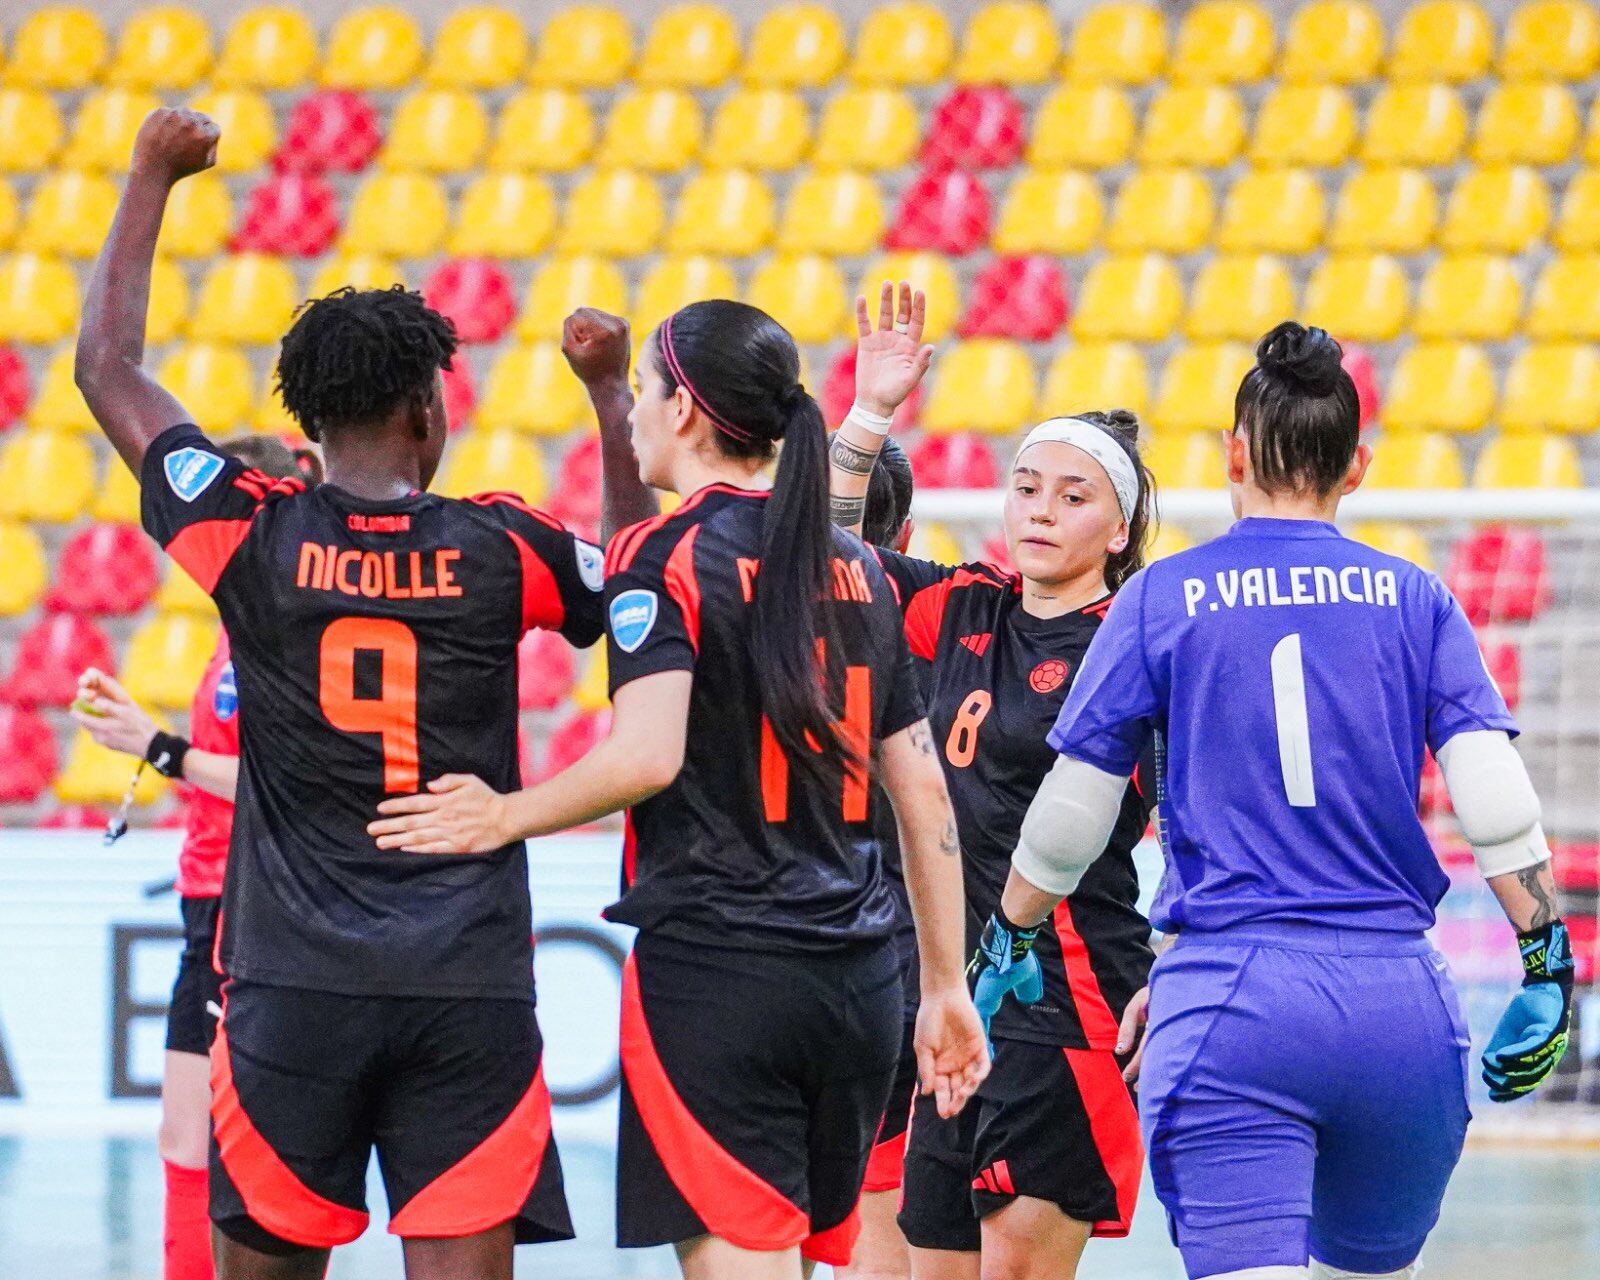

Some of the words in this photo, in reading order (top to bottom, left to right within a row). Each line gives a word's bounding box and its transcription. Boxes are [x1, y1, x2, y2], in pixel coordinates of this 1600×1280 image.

[297, 541, 463, 599] NICOLLE
[736, 557, 872, 604] MNA
[1183, 566, 1398, 617] P.VALENCIA
[319, 616, 419, 793] 9
[945, 689, 992, 768] 8
[1270, 632, 1316, 807] 1
